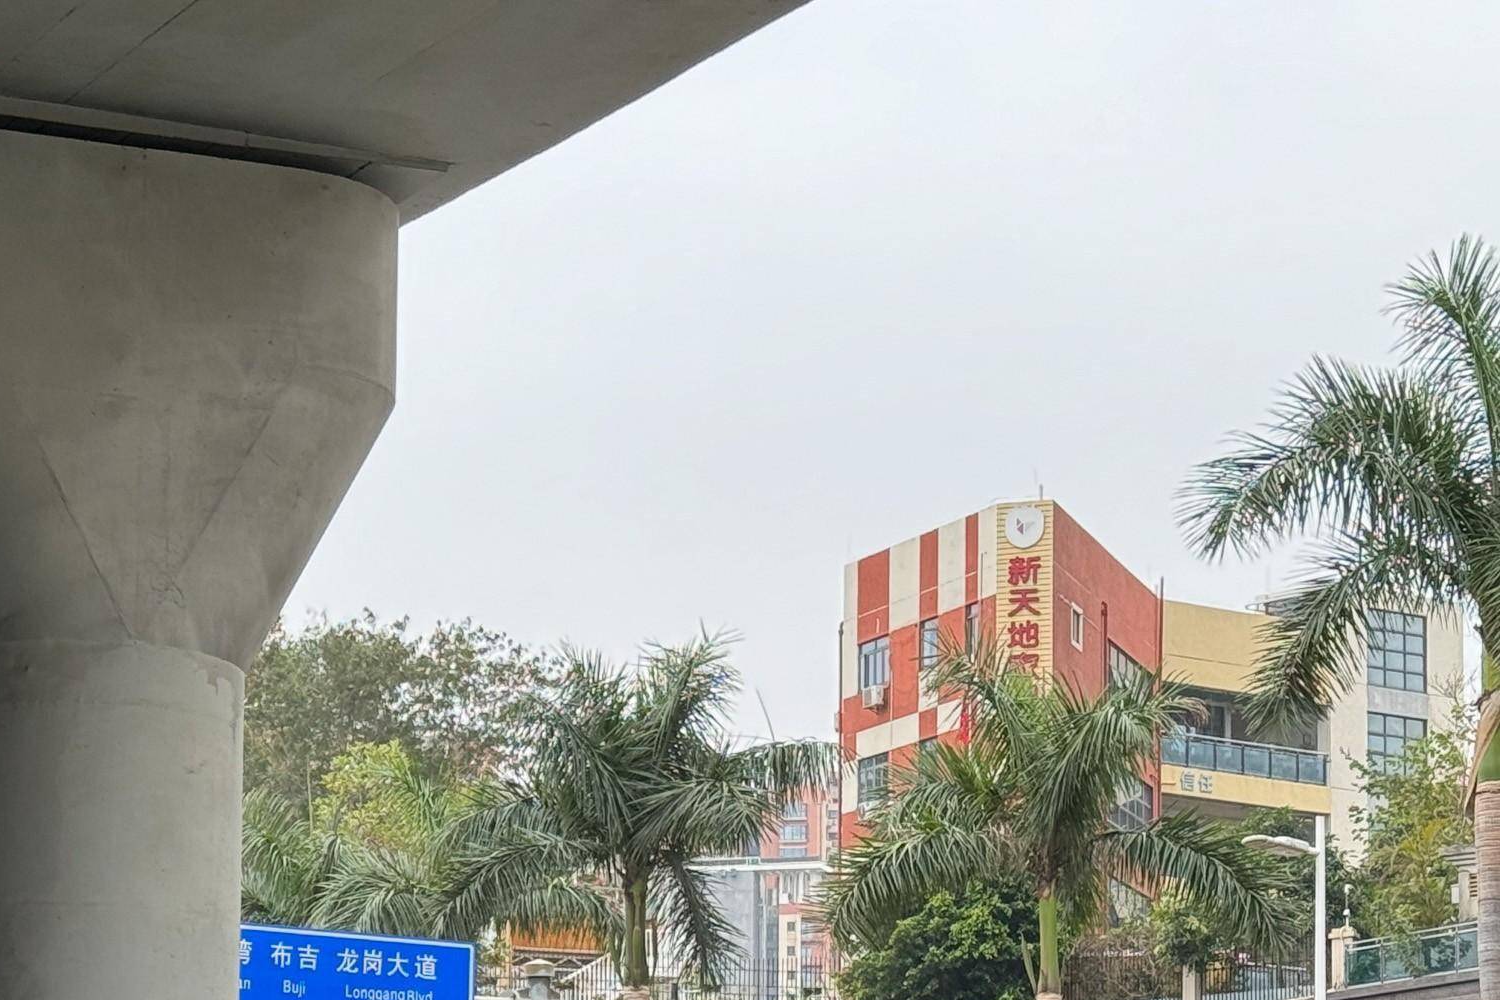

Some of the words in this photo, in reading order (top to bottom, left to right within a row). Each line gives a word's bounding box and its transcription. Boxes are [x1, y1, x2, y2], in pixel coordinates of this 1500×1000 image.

[270, 941, 320, 971] 布吉
[336, 947, 438, 980] 龙岗大道
[283, 979, 306, 998] Buji
